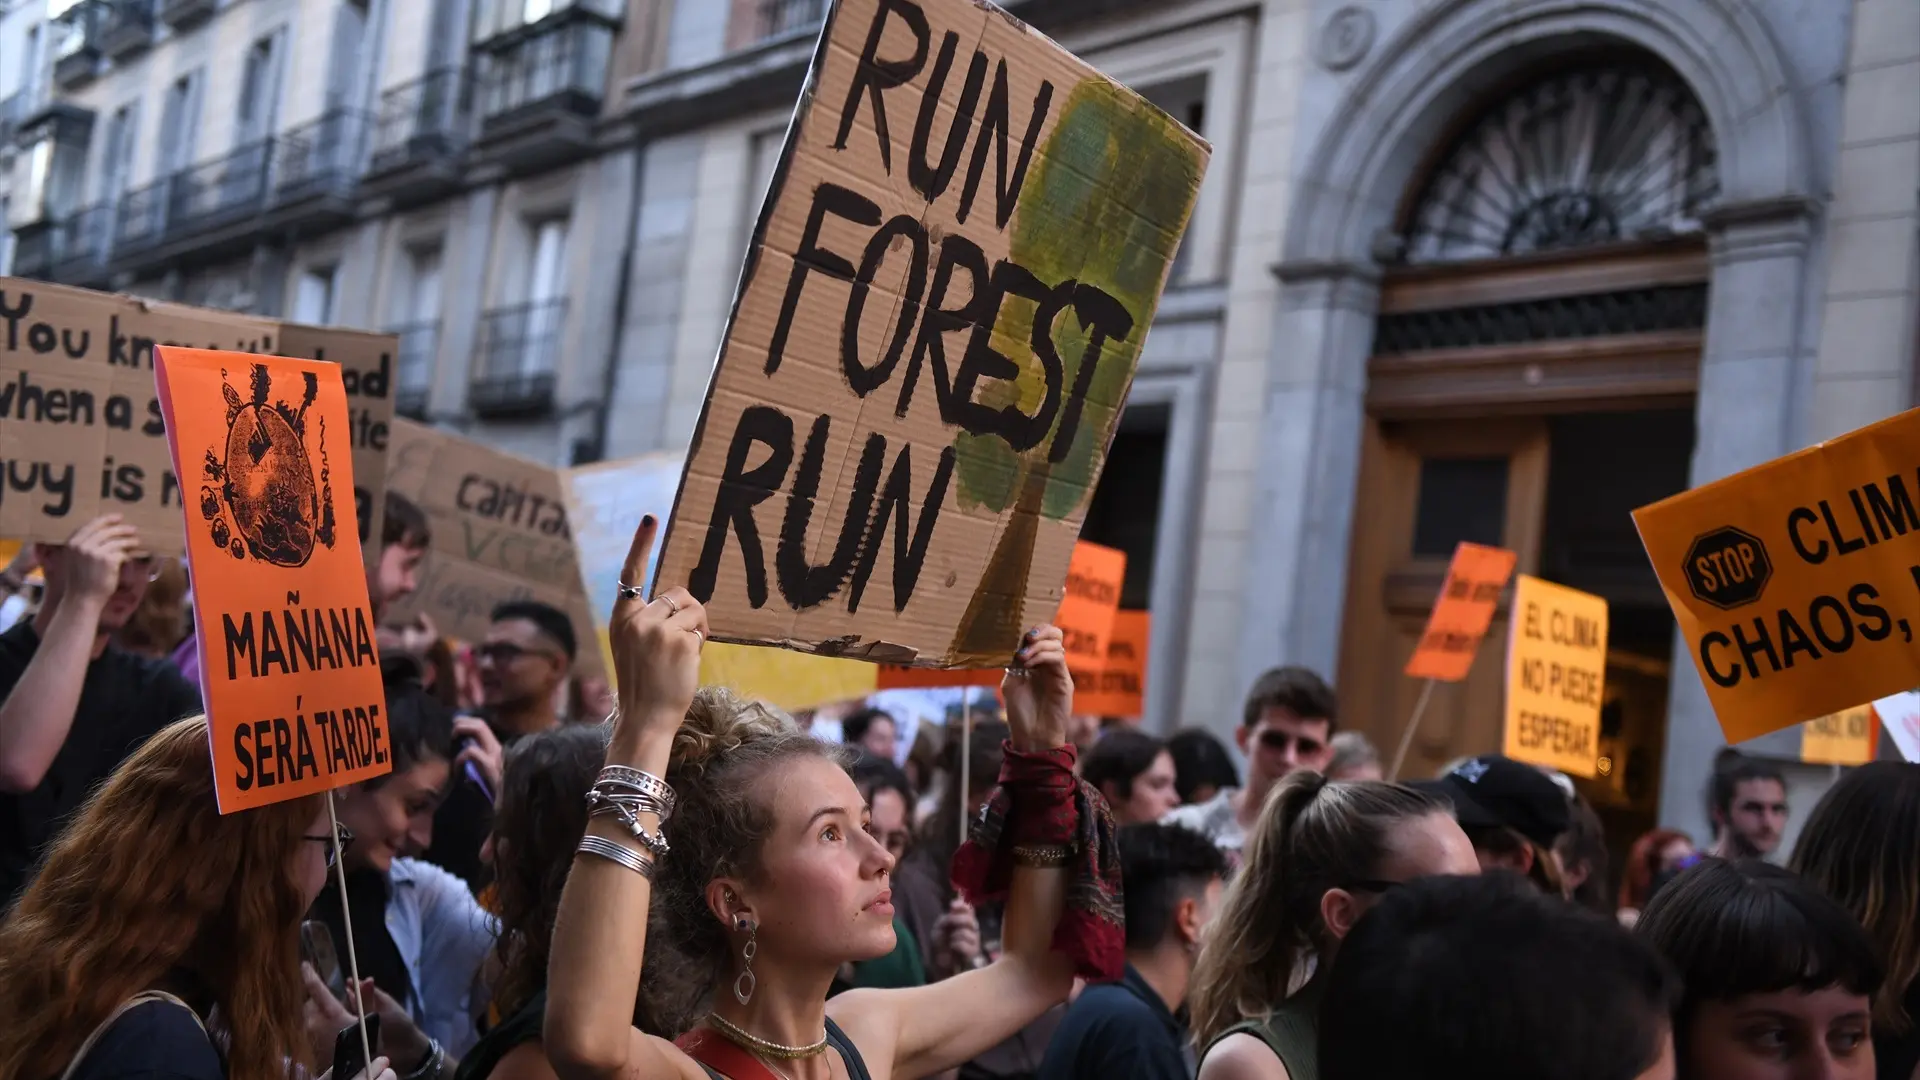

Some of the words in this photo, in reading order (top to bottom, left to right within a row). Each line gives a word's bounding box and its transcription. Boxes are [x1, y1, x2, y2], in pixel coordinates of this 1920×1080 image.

[826, 0, 1054, 233] RUN
[0, 289, 90, 358] You
[108, 315, 200, 370] kn
[316, 349, 390, 398] ad
[763, 183, 1134, 462] FOREST
[105, 395, 131, 431] a
[0, 458, 73, 517] uy
[101, 455, 144, 502] is
[688, 406, 955, 614] RUN
[1788, 466, 1920, 564] CLIM
[1696, 543, 1755, 593] STOP
[222, 590, 376, 680] MAÑANA
[1524, 601, 1543, 641] EL
[1550, 608, 1599, 650] CLIMA
[1700, 583, 1913, 688] CHAOS,
[1520, 657, 1545, 694] NO
[1549, 662, 1599, 708] PUEDE
[234, 695, 319, 791] SERÁ
[314, 705, 388, 775] TARDE.
